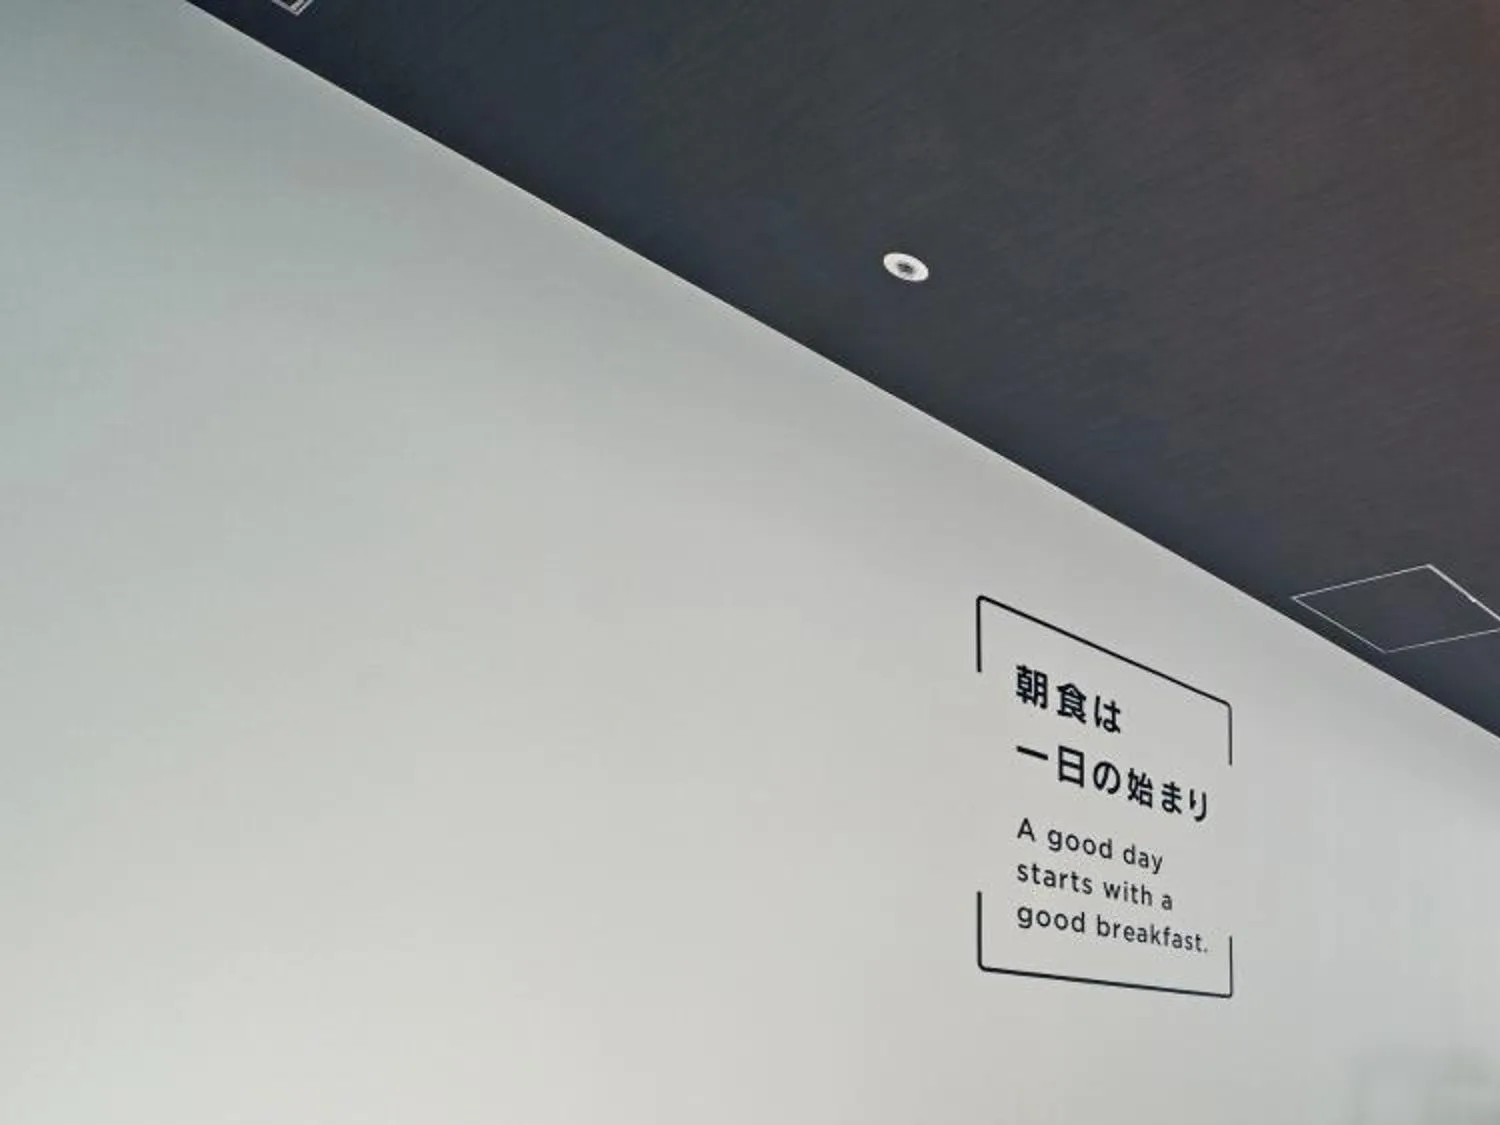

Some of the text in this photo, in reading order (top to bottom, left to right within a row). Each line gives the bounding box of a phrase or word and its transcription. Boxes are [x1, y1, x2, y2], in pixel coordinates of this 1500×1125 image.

[1016, 664, 1122, 735] 朝食は
[1016, 745, 1208, 822] 一日の始まり
[1016, 817, 1164, 875] A good day
[1016, 862, 1173, 911] starts with a
[1016, 905, 1209, 954] good breakfast.
